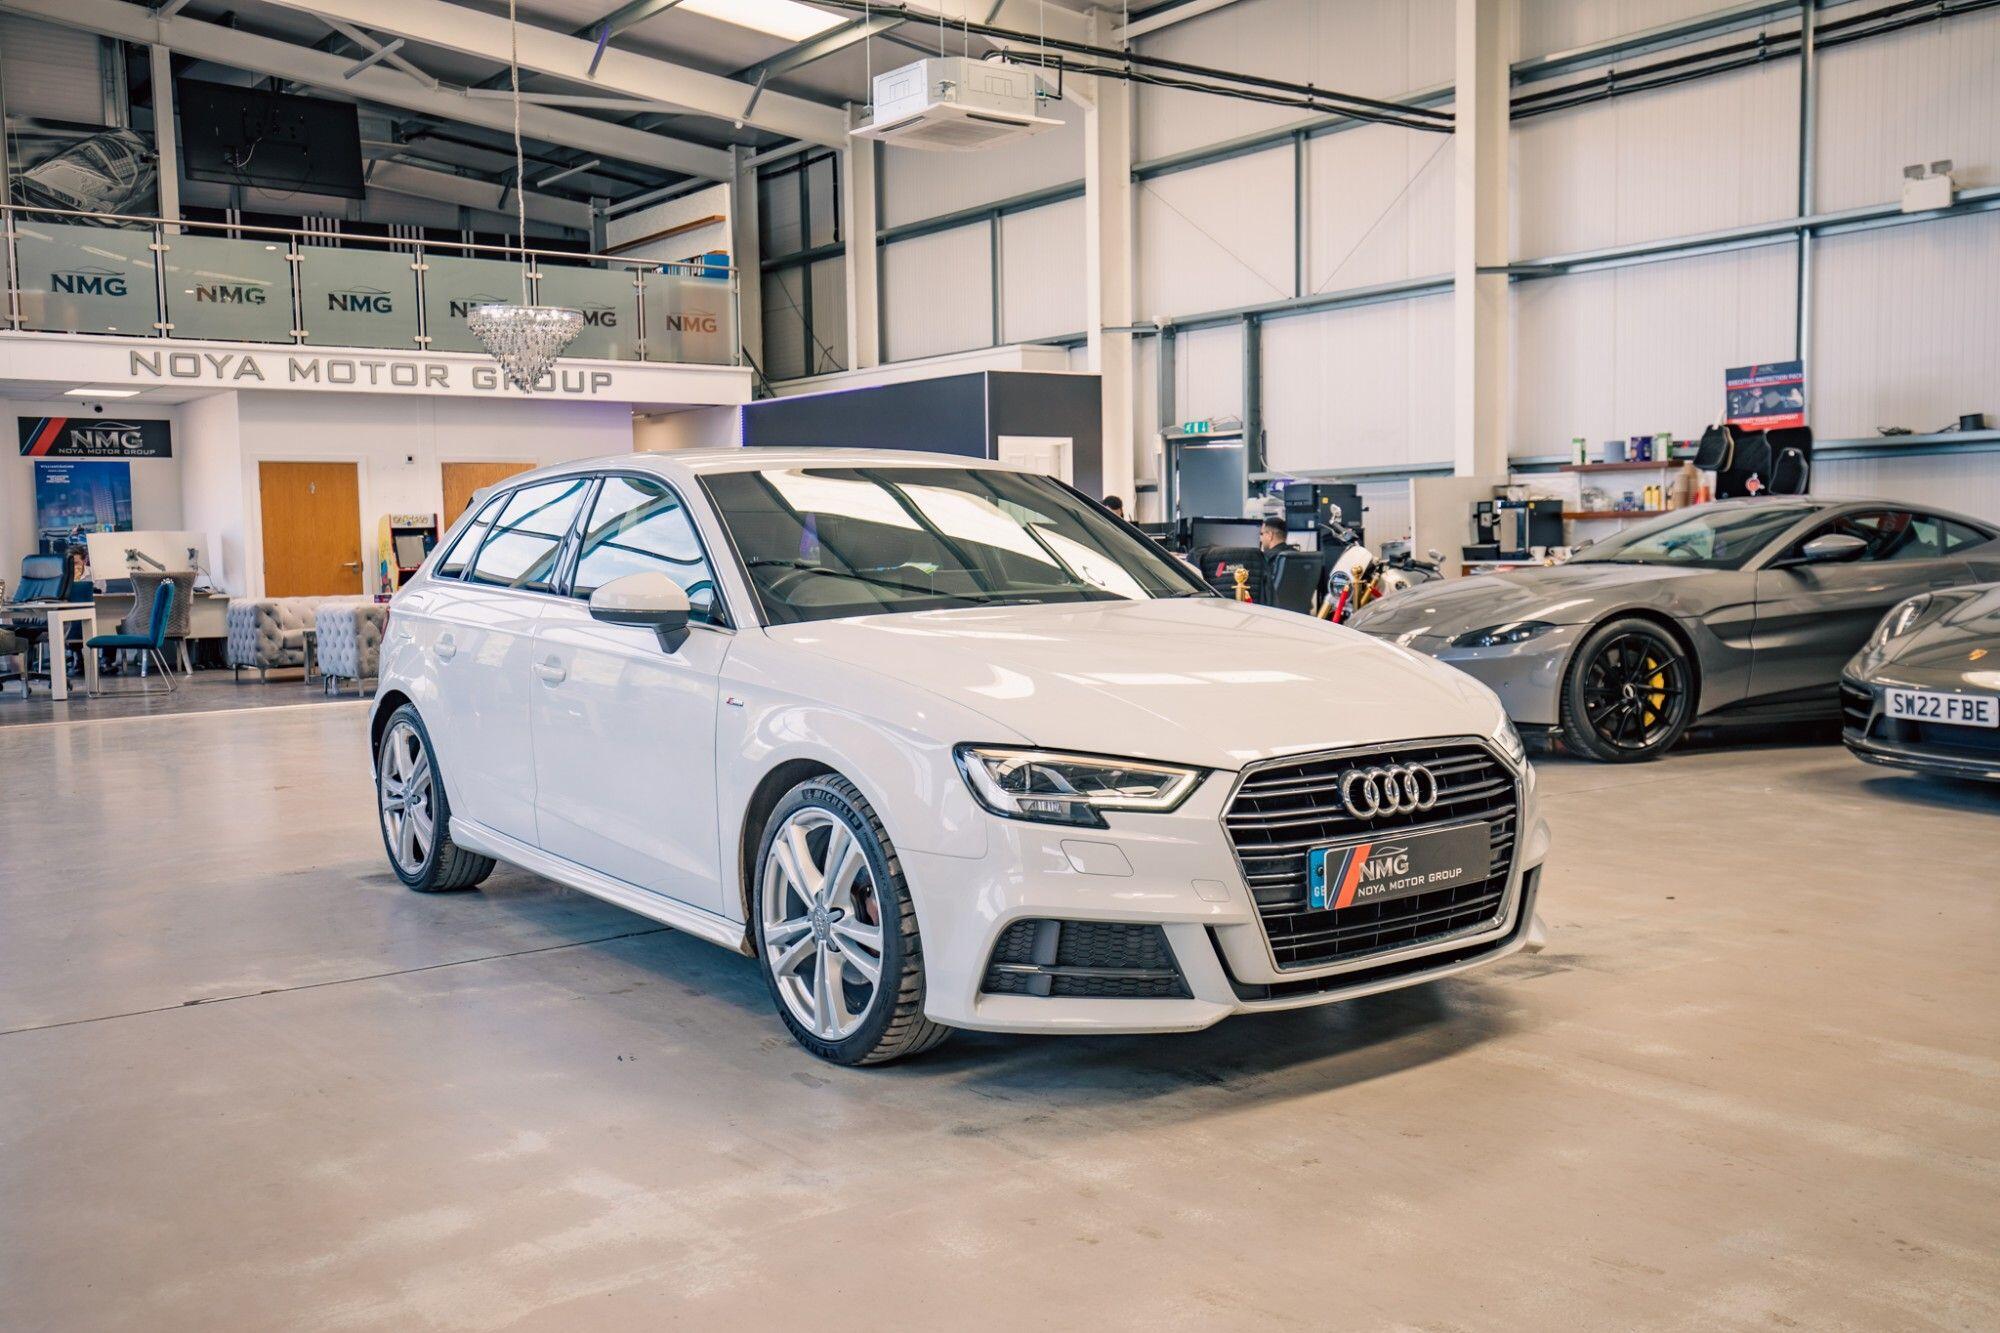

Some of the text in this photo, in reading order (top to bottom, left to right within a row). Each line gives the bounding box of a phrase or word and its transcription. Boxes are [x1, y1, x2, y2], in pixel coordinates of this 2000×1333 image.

[51, 272, 128, 297] NMG
[196, 284, 266, 305] NMG
[328, 293, 393, 314] NMG
[583, 310, 617, 328] MG
[666, 315, 718, 333] NMG
[130, 350, 265, 381] NOYA
[289, 357, 449, 388] MOTOR
[70, 430, 143, 449] NMG
[1893, 693, 1990, 723] SW22 FBE
[813, 790, 859, 827] MICHELIN
[1358, 853, 1410, 883] NMG
[1357, 867, 1463, 898] NOYA MOTOR GROUP
